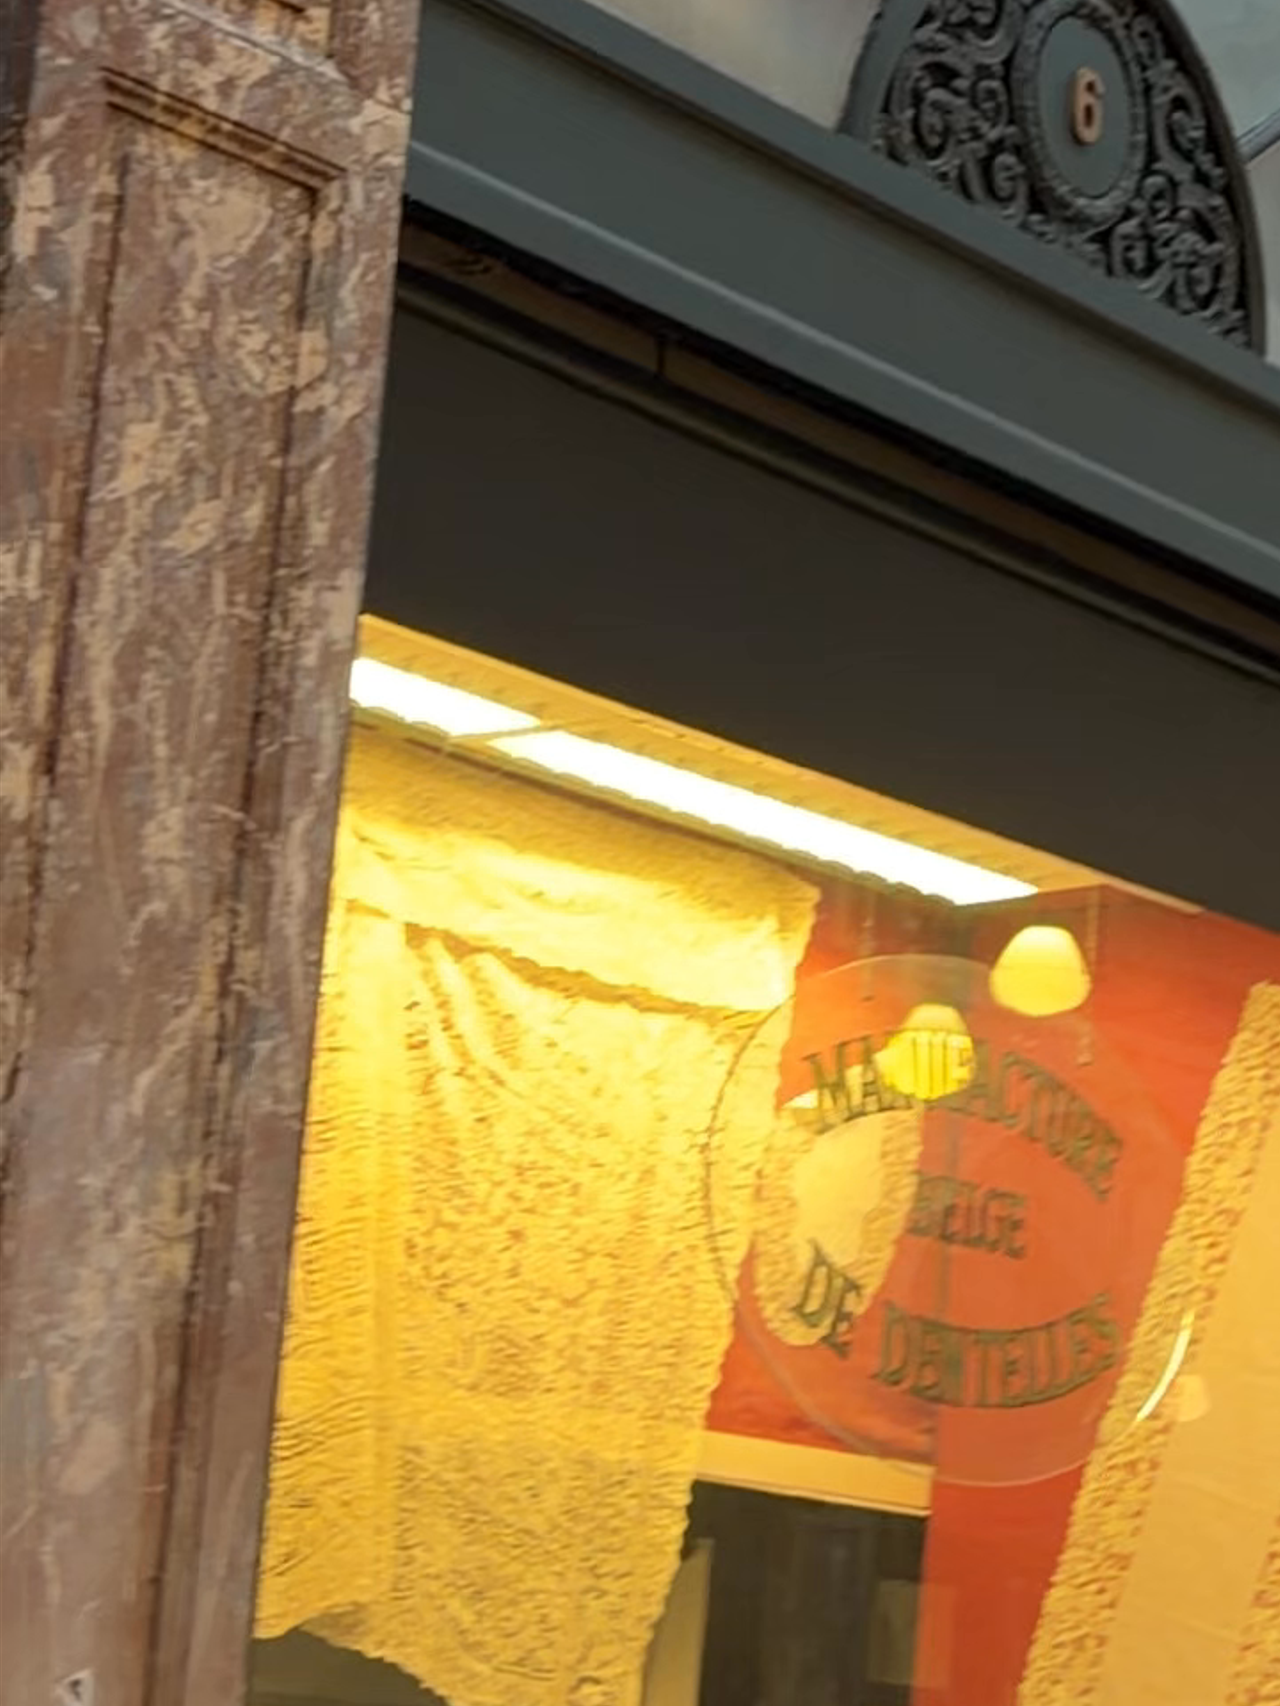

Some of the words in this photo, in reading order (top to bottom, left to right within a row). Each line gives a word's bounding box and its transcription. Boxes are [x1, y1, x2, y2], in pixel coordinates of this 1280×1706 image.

[1073, 65, 1106, 144] 6
[907, 1174, 1026, 1259] BELGE
[792, 1238, 862, 1360] DE
[870, 1292, 1119, 1408] DENTELLES
